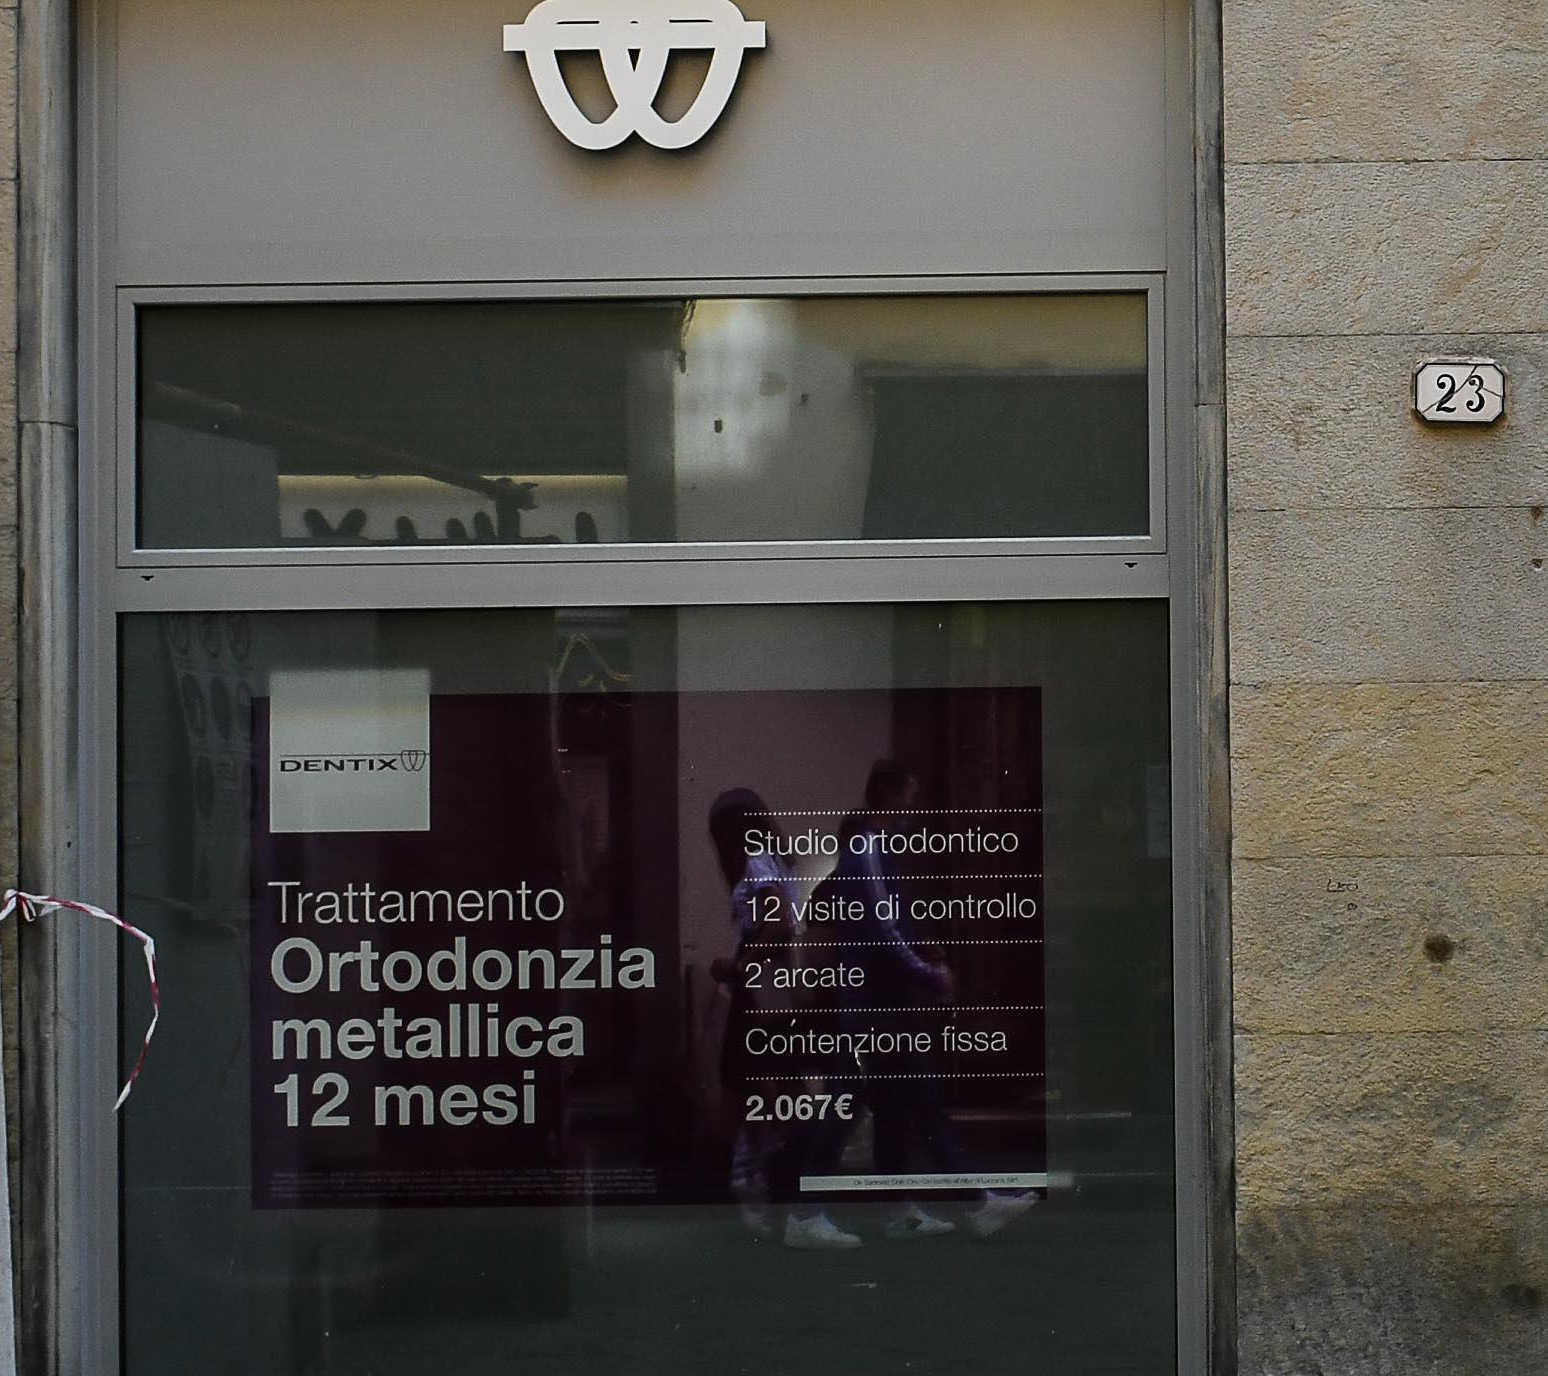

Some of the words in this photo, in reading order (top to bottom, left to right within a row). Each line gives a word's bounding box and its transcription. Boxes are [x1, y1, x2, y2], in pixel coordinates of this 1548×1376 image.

[1436, 374, 1485, 413] 23
[280, 758, 397, 772] DENTIX
[744, 828, 838, 856] Studio
[849, 827, 1019, 855] ortodontico
[268, 881, 564, 924] Trattamento
[746, 896, 781, 922] 12
[791, 895, 865, 921] visite
[875, 893, 900, 920] di
[910, 893, 1037, 920] controllo
[270, 935, 656, 993] Ortodonzia
[745, 962, 762, 988] 2
[773, 962, 865, 987] arcate
[272, 1003, 585, 1059] metallica
[745, 1027, 932, 1055] Contenzione
[941, 1026, 1008, 1052] fissa
[274, 1073, 350, 1127] 12
[375, 1071, 535, 1126] mesi
[745, 1094, 854, 1121] 2.067€
